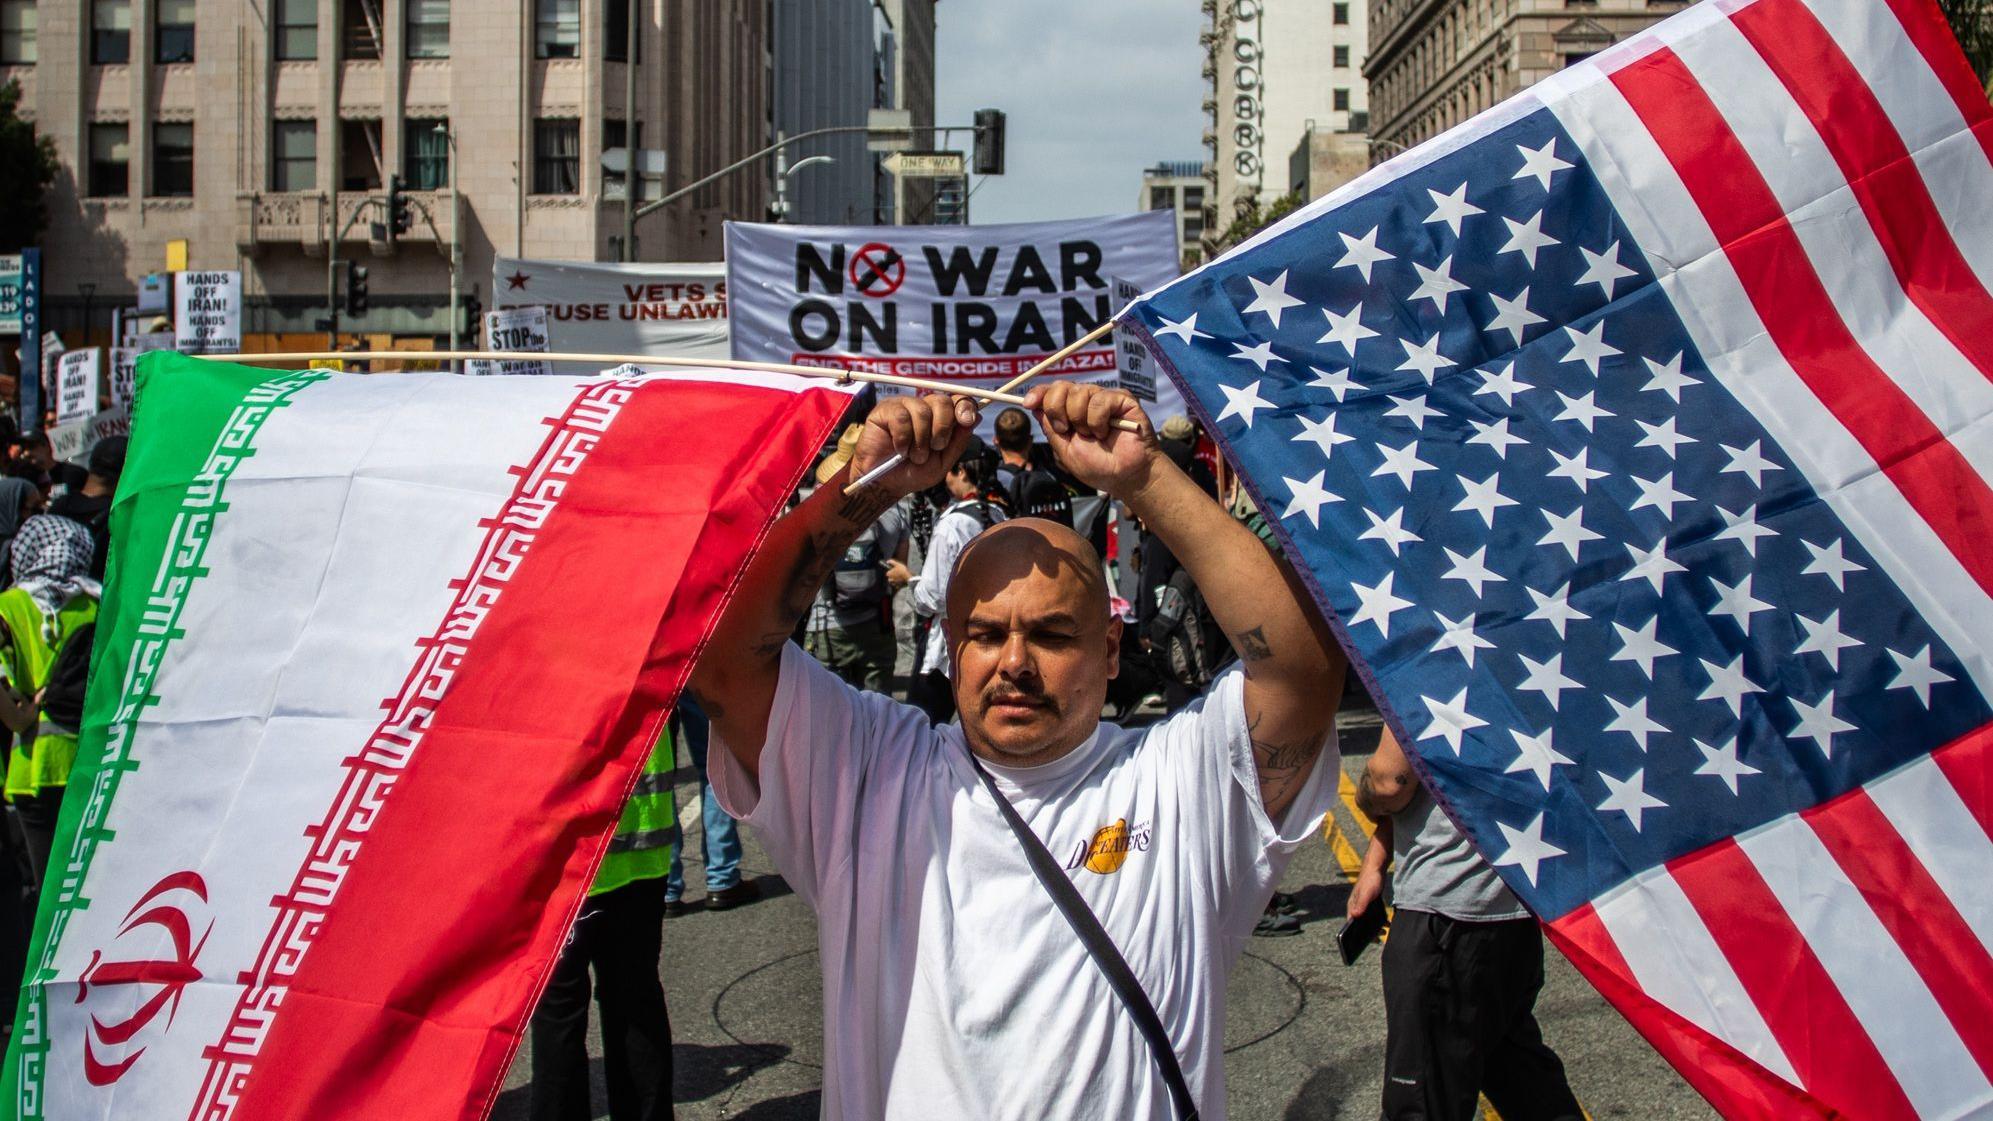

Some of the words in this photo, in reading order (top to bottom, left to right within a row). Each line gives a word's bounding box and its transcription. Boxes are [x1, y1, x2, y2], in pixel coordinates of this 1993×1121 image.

[1234, 38, 1258, 176] CLARK
[900, 157, 925, 168] ONE
[932, 157, 955, 168] WAY
[921, 240, 1108, 297] WAR
[187, 273, 229, 285] HANDS
[194, 287, 217, 298] OFF
[623, 283, 705, 302] VETS
[24, 263, 35, 340] LADOT
[187, 299, 227, 312] IRAN!
[618, 303, 727, 321] UNLAW
[189, 316, 226, 326] HANDS
[788, 299, 898, 354] ON
[931, 295, 1113, 354] IRAN
[195, 328, 216, 338] OFF
[491, 327, 530, 350] STOP
[848, 361, 892, 373] THE
[896, 361, 1012, 375] GENOCIDE
